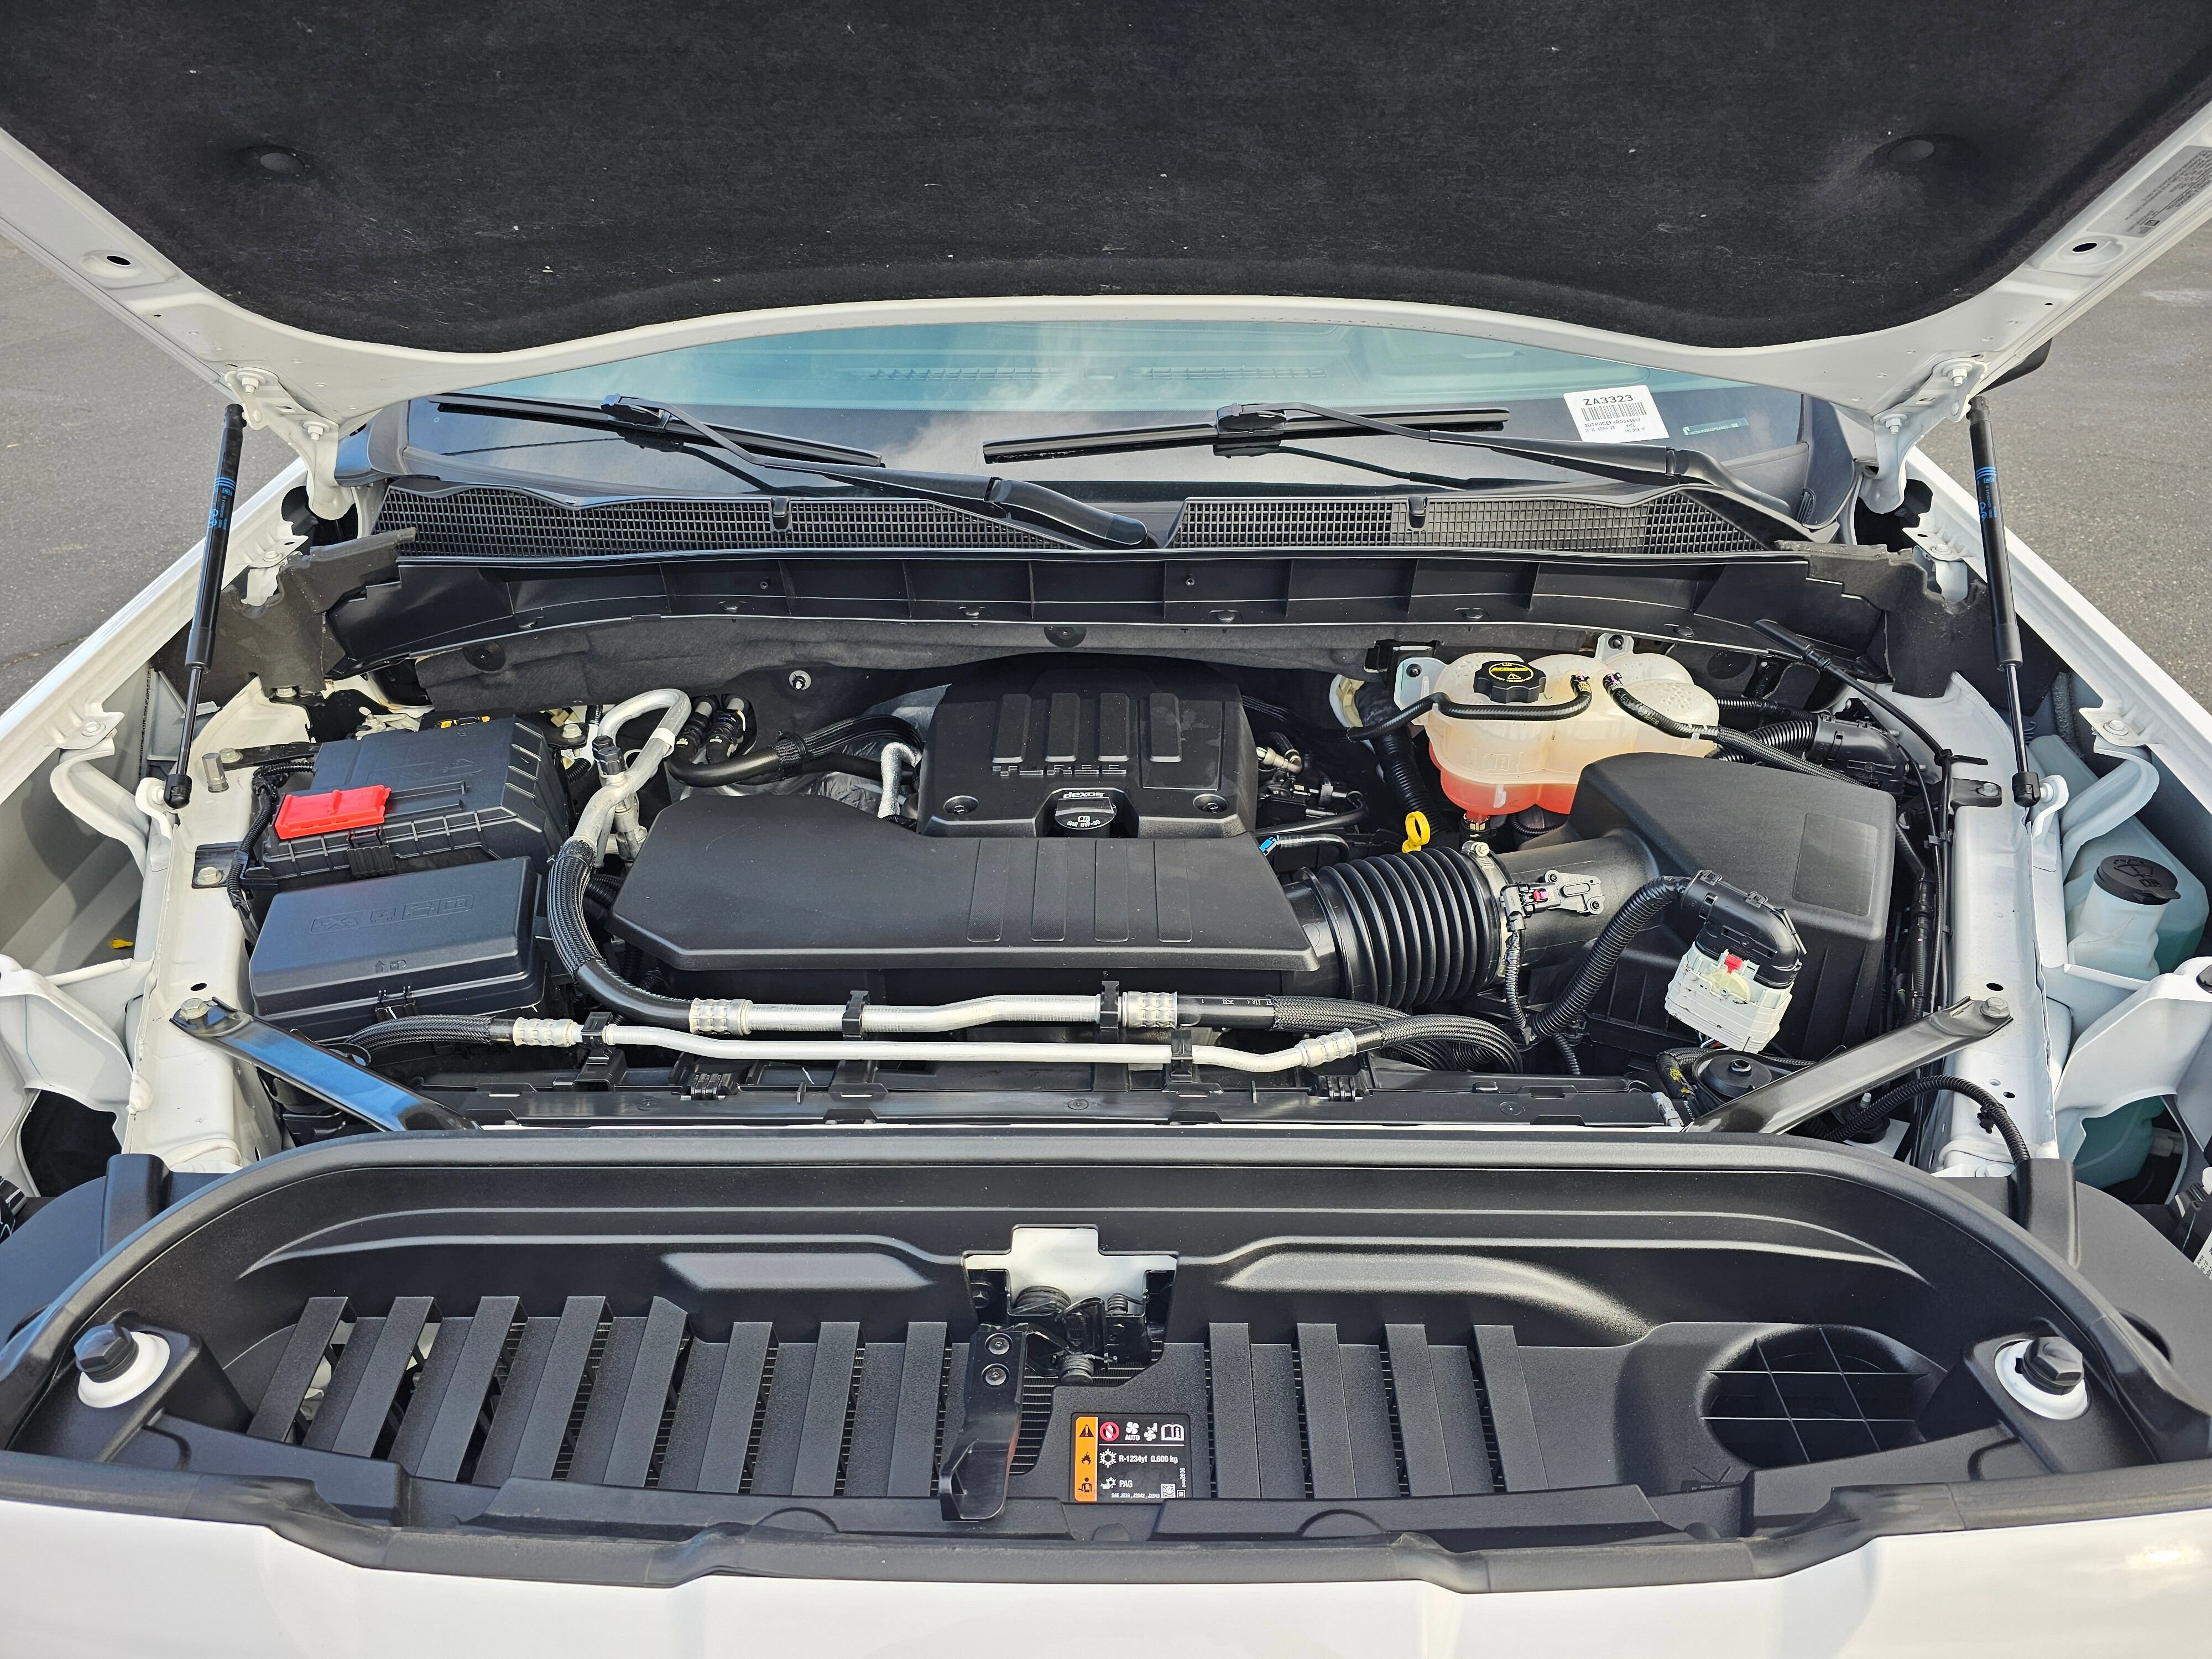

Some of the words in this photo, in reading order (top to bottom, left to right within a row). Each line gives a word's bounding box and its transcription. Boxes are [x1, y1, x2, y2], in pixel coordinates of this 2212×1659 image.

[1583, 395, 1634, 405] ZA3323
[1119, 1455, 1147, 1464] R-1234yf
[1170, 1455, 1178, 1464] kg
